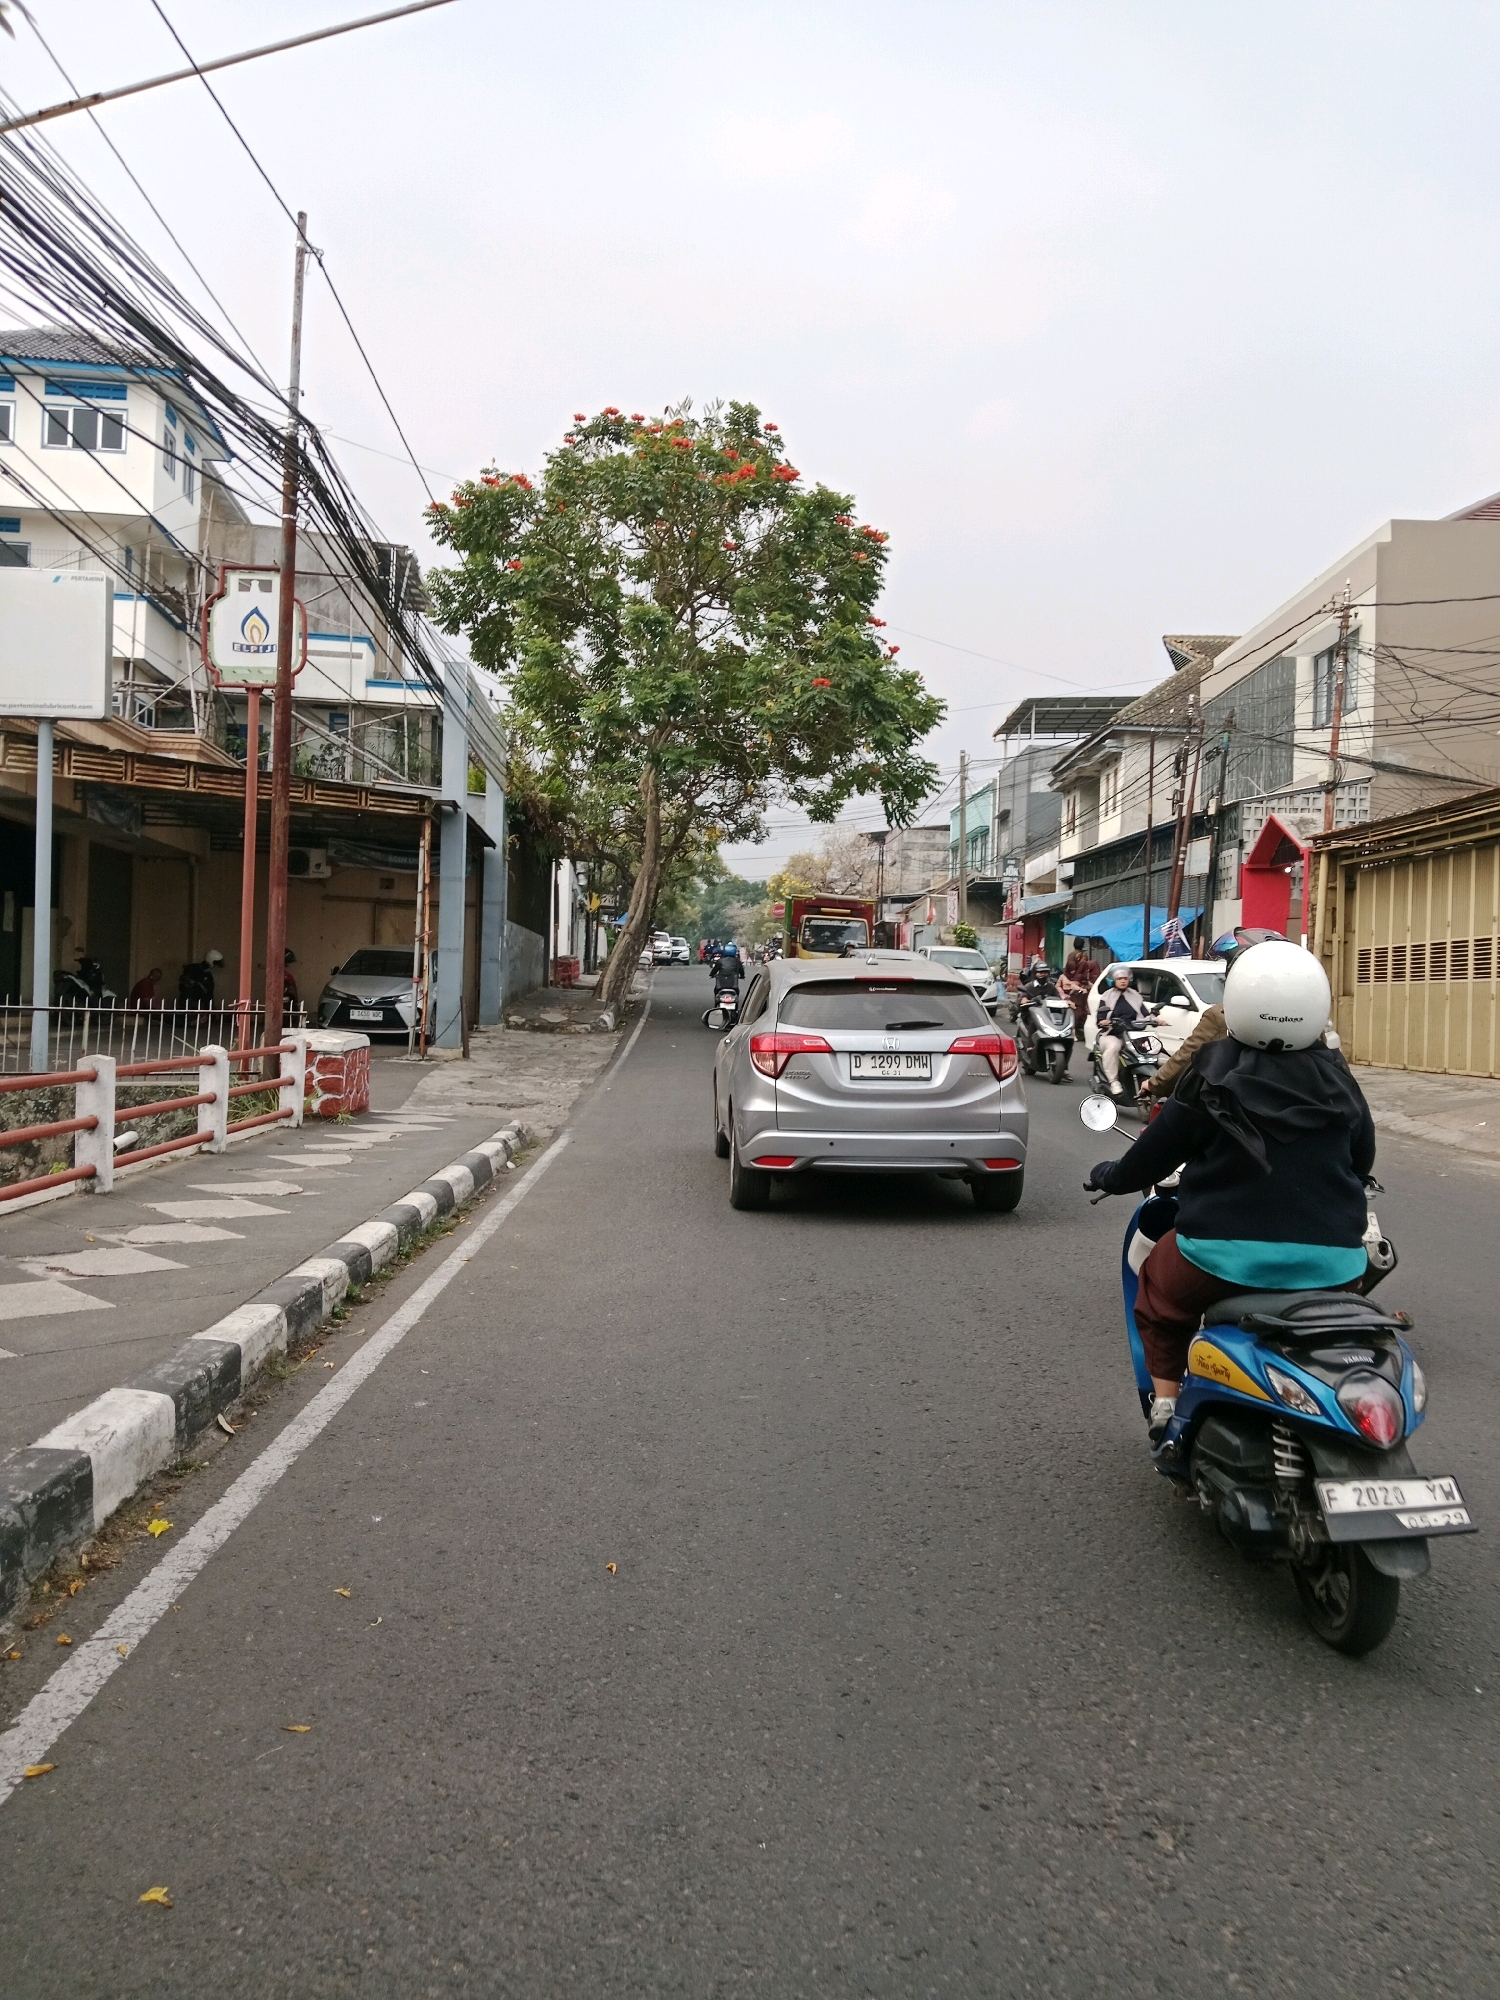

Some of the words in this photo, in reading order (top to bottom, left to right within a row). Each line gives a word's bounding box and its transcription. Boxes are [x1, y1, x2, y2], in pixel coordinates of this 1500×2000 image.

[233, 643, 276, 653] ELPIJI
[854, 1055, 862, 1068] D
[870, 1055, 901, 1068] 1299
[905, 1055, 928, 1068] DMW
[1342, 1355, 1375, 1364] YAMAHA
[1325, 1488, 1338, 1509] F
[1351, 1486, 1407, 1508] 2020
[1425, 1481, 1457, 1502] YW
